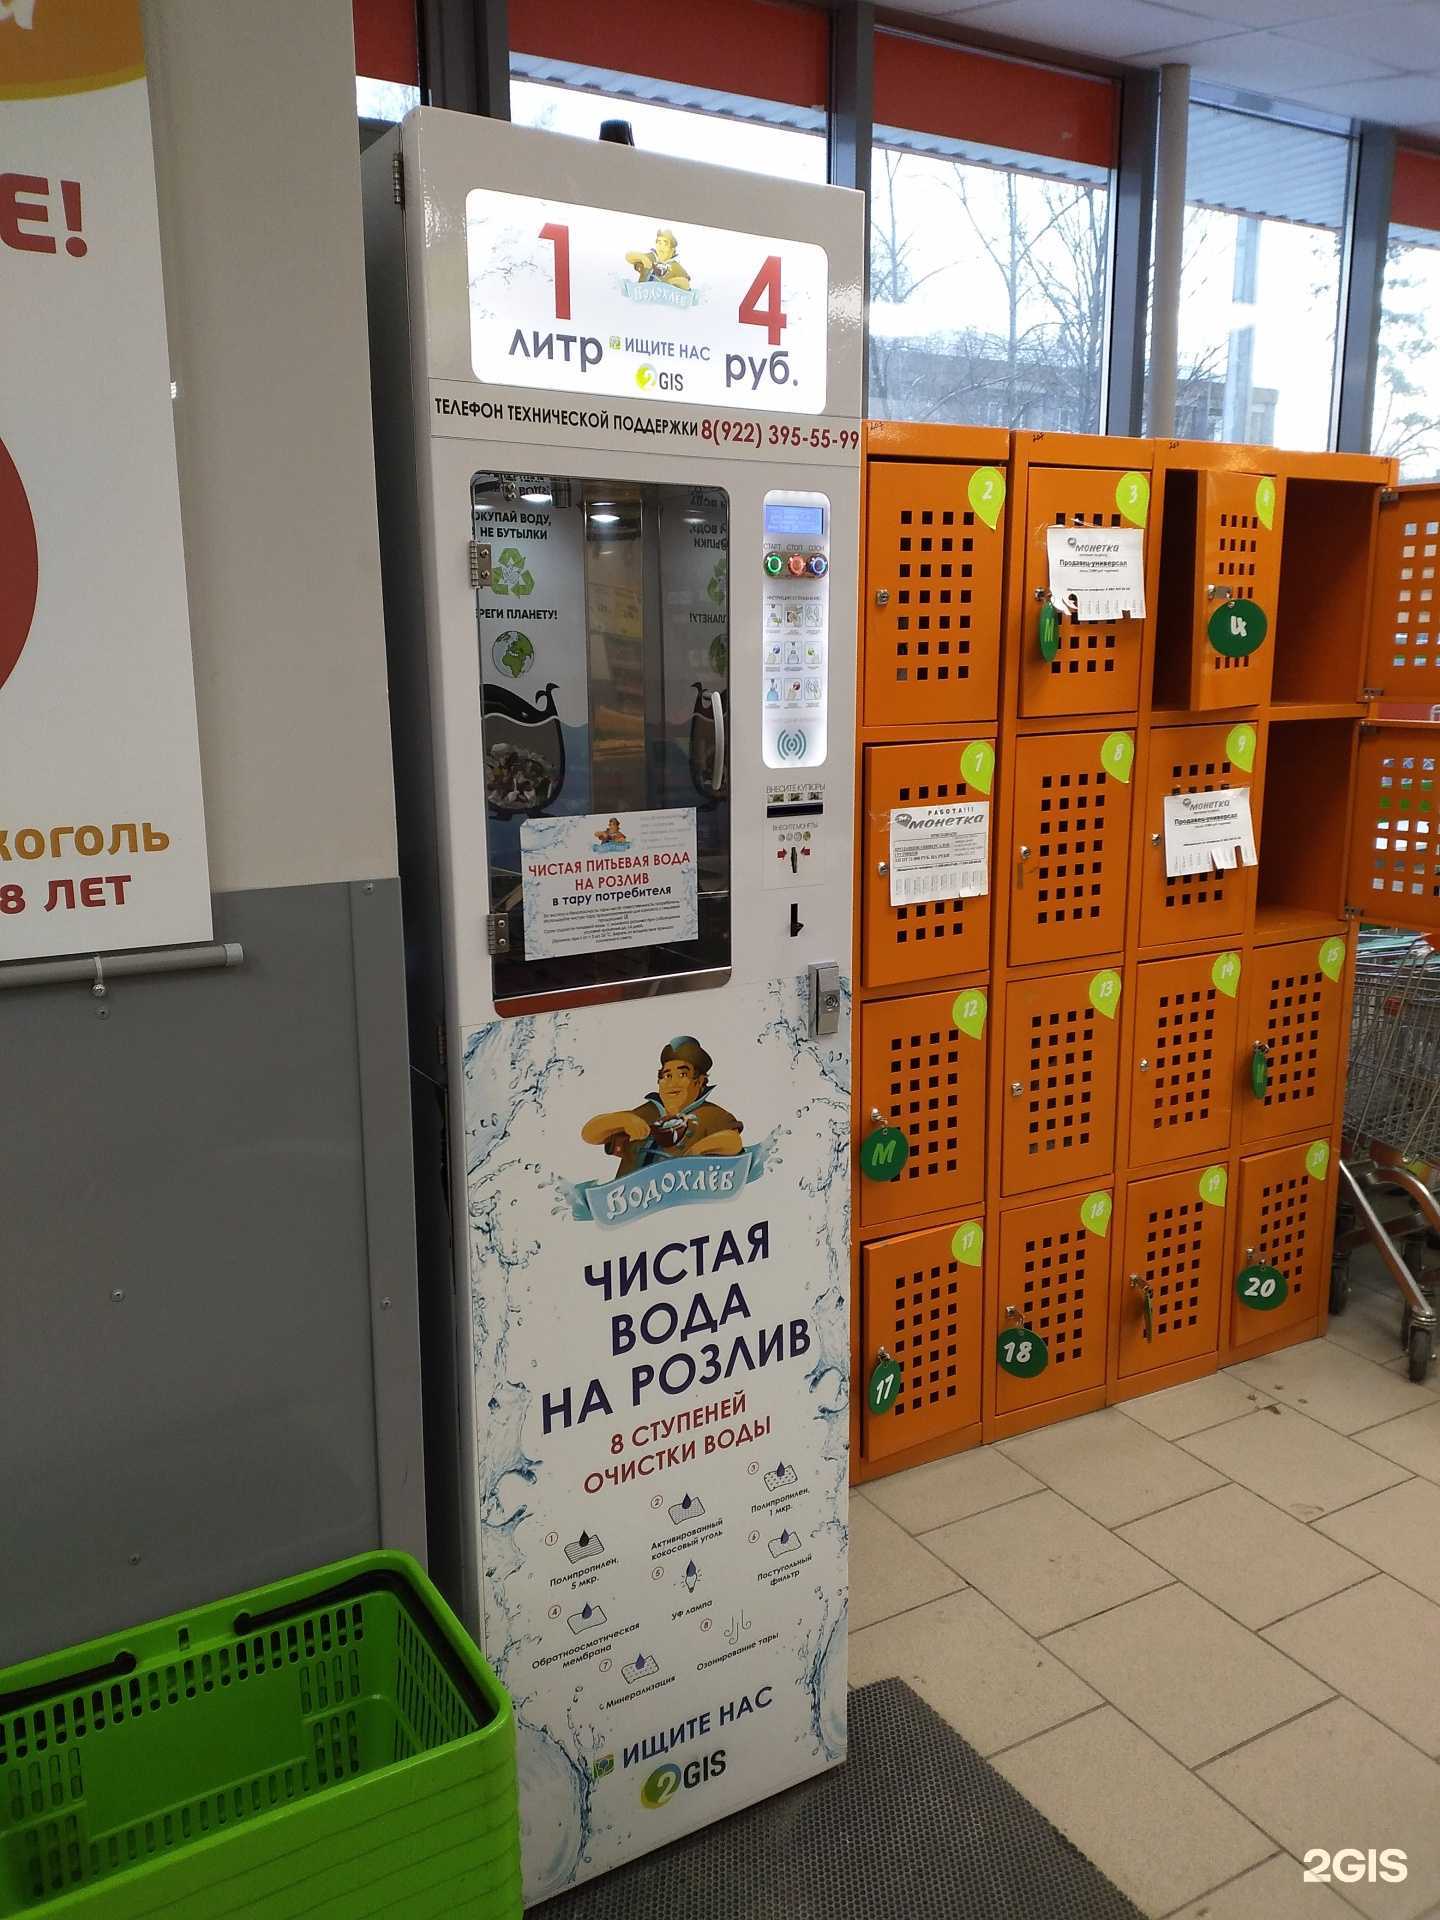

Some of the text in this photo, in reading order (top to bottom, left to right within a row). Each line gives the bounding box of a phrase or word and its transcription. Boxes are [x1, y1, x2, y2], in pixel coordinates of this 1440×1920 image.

[538, 222, 571, 320] 1
[738, 255, 787, 346] 4
[508, 328, 603, 372] литр
[625, 337, 711, 361] ИЩИТЕ НАС
[725, 349, 798, 390] руб.
[435, 397, 503, 420] ТЕЛЕФОН
[507, 403, 609, 430] ТЕХНИЧЕСКОЙ
[613, 414, 698, 438] ПОДДЕРЖКИ
[701, 418, 762, 448] 8(922)
[768, 423, 859, 450] 395-55-99
[982, 480, 993, 499] 2
[1129, 485, 1138, 503] 3
[480, 528, 548, 540] НЕ БУТЫЛКИ
[520, 513, 551, 526] ВОДУ,
[507, 608, 558, 620] ПЛАНЕТУ!
[767, 784, 797, 793] ВНЕСИТЕ
[528, 851, 691, 877] ЧИСТАЯ ПИТЬЕВАЯ ВОДА
[44, 874, 132, 912] ЛЕТ
[575, 872, 650, 891] НА РОЗЛИВ
[552, 885, 672, 908] в тару потребителя
[1099, 980, 1113, 998] 13
[963, 1000, 978, 1018] 12
[1090, 1201, 1105, 1219] 18
[584, 1220, 769, 1302] ЧИСТАЯ
[1244, 1276, 1276, 1298] 20
[611, 1282, 751, 1356] ВОДА
[1003, 1341, 1033, 1363] 18
[542, 1318, 812, 1435] НА РОЗЛИВ
[610, 1390, 747, 1455] 8 СТУПЕНЕЙ
[584, 1415, 771, 1494] ОЧИСТКИ ВОДЫ
[651, 1517, 724, 1551] Активированный
[651, 1530, 724, 1561] кокосовый уголь
[757, 1553, 813, 1582] Постугольный
[685, 1600, 713, 1616] лампа
[532, 1622, 641, 1670] Обратноосмотическая
[562, 1643, 613, 1669] мембрана
[696, 1632, 780, 1671] Озонирование тары
[623, 1686, 773, 1769] ИЩИТЕ НАС
[647, 1749, 727, 1806] 2GIS
